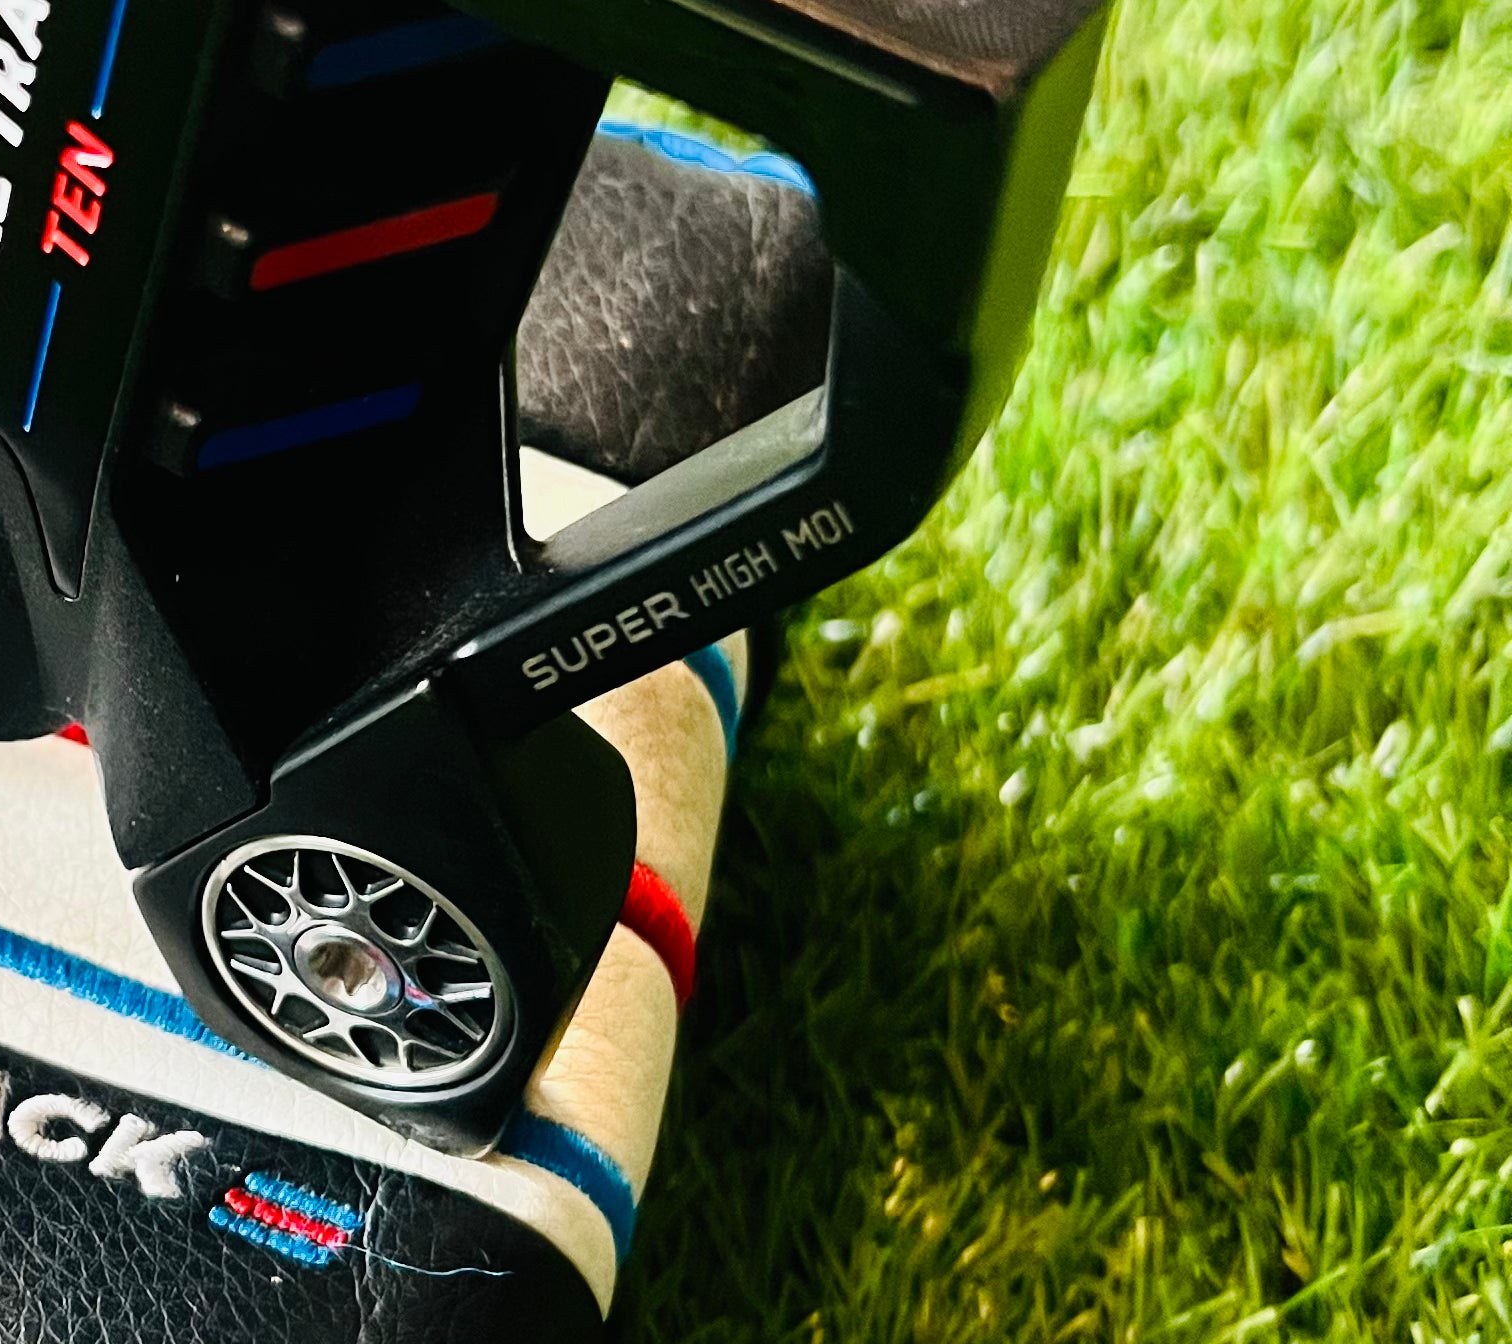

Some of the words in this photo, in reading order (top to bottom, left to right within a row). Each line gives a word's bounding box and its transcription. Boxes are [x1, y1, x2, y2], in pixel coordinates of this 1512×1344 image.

[41, 119, 114, 267] TEN
[521, 591, 691, 690] SUPER
[689, 540, 779, 607] HIGH
[780, 502, 854, 561] MOI
